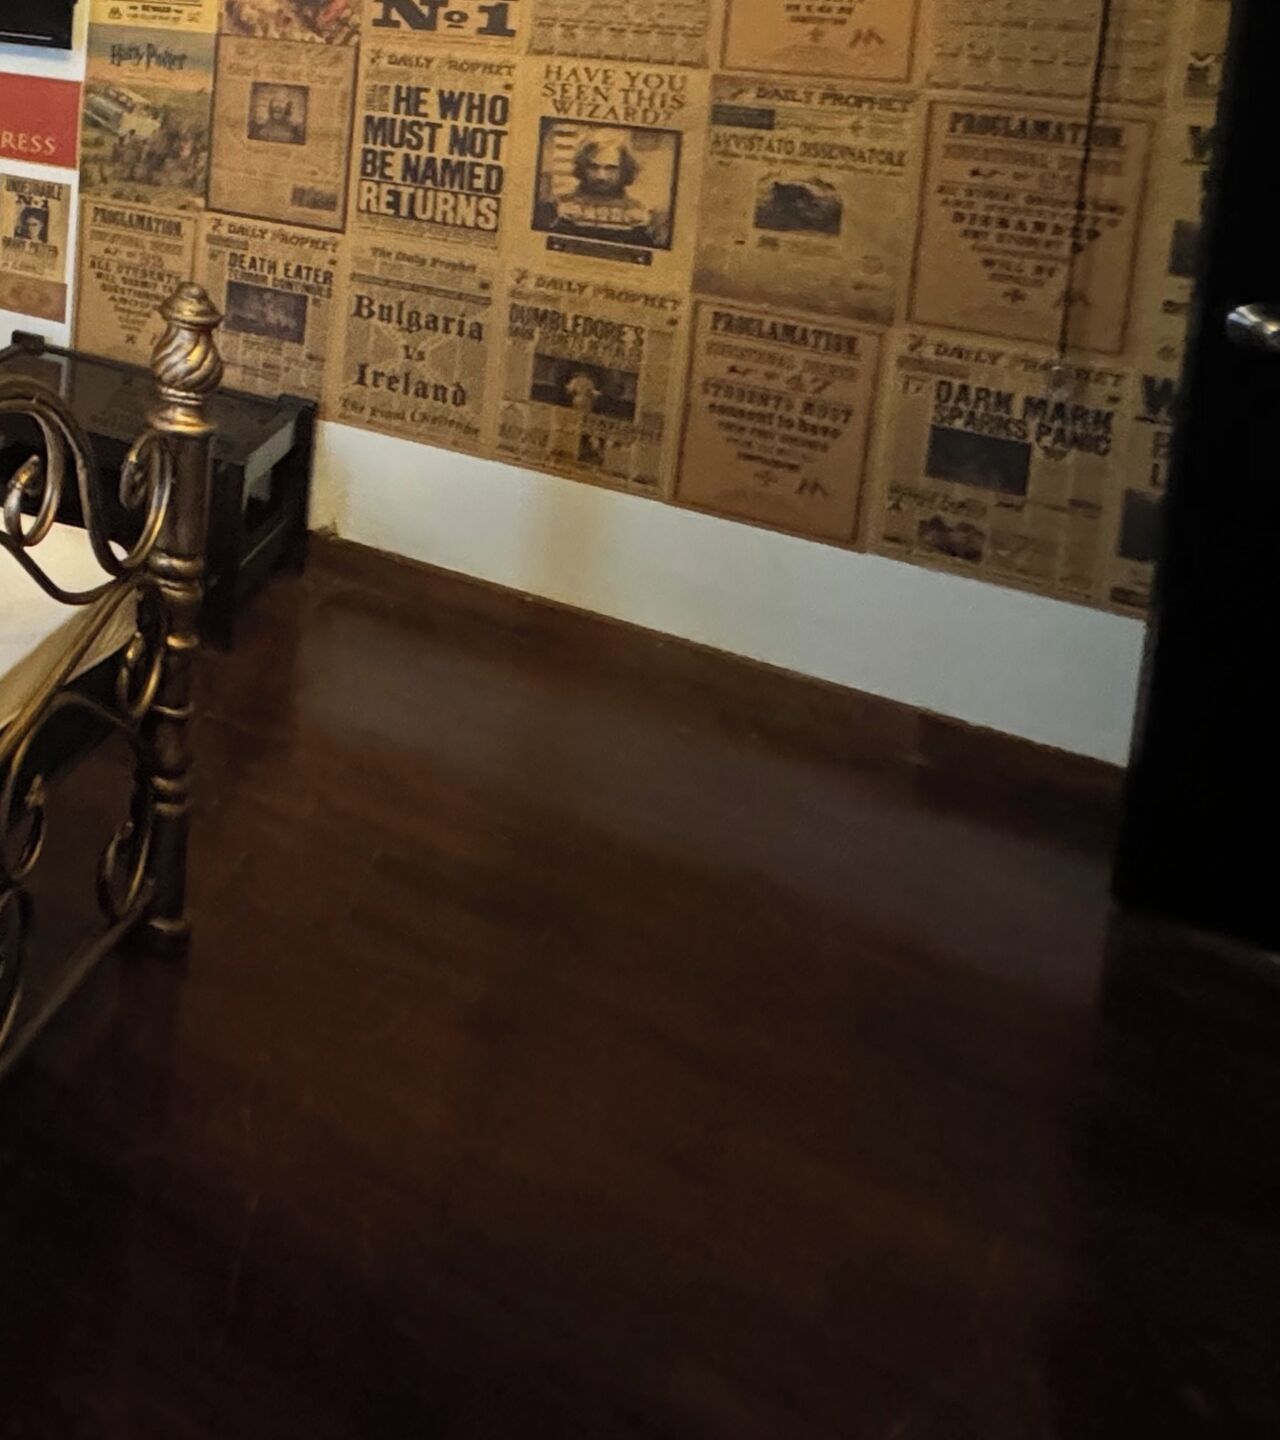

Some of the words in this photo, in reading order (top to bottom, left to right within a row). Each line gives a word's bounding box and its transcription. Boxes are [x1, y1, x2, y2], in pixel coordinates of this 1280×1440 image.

[387, 54, 433, 69] DAILY
[544, 64, 616, 86] HAVE
[625, 71, 688, 92] YOU
[394, 84, 431, 118] HE
[438, 89, 510, 126] WHO
[541, 82, 610, 103] SEEN
[619, 88, 688, 110] THIS
[551, 98, 676, 125] WIZARD?
[364, 115, 443, 154] MUST
[448, 124, 508, 161] NOT
[360, 147, 395, 183] BE
[401, 152, 505, 196] NAMED
[359, 180, 499, 231] RETURNS
[92, 207, 182, 237] PROCLAMATION
[227, 223, 268, 240] DAILY
[228, 252, 277, 275] DEATH
[283, 261, 334, 285] EATER
[534, 274, 589, 295] DAILY
[350, 294, 484, 343] Bulgaria
[935, 342, 1006, 364] DAILY
[354, 361, 468, 408] Ireland
[935, 380, 1015, 415] DARK
[1023, 396, 1115, 432] MARK
